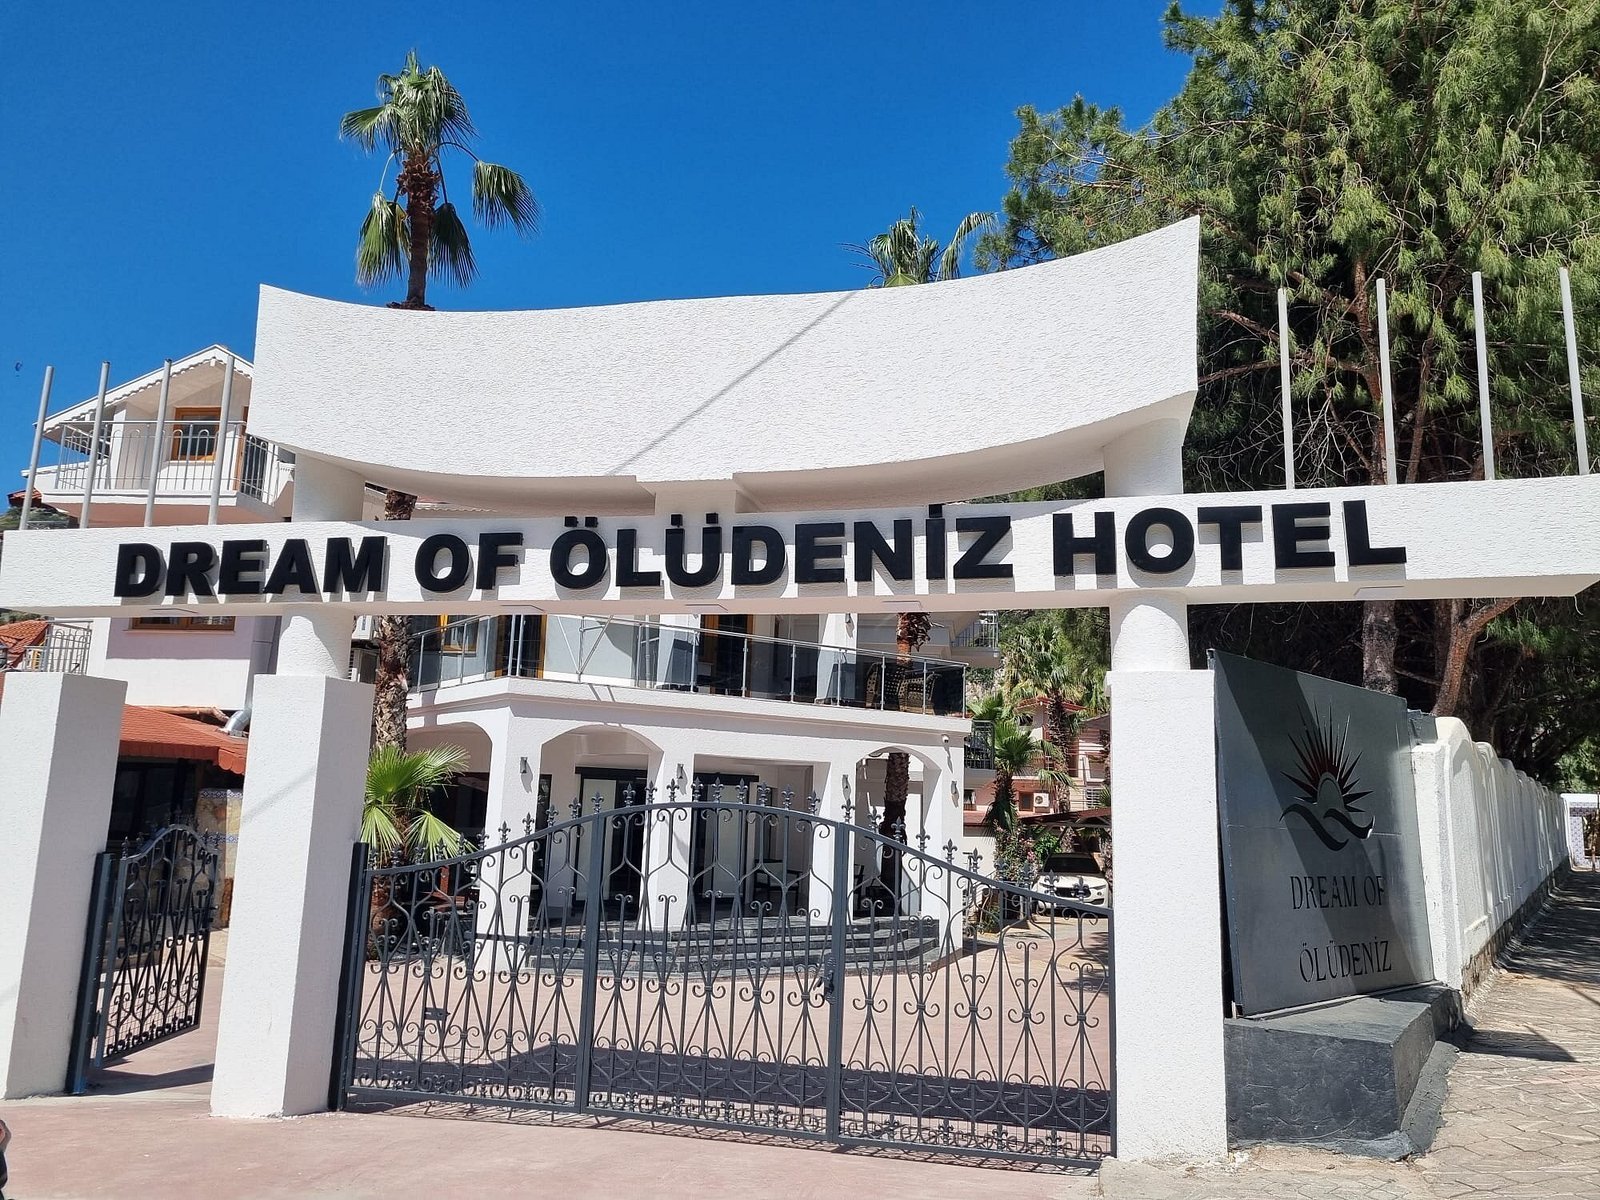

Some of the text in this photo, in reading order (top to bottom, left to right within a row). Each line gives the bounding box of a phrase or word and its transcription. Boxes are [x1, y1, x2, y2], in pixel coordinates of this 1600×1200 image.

[113, 500, 1406, 598] DREAM OF ÖLÜDENİZ HOTEL
[1291, 875, 1385, 909] DREAM OF
[1301, 938, 1391, 982] ÖLÜDENİZ
